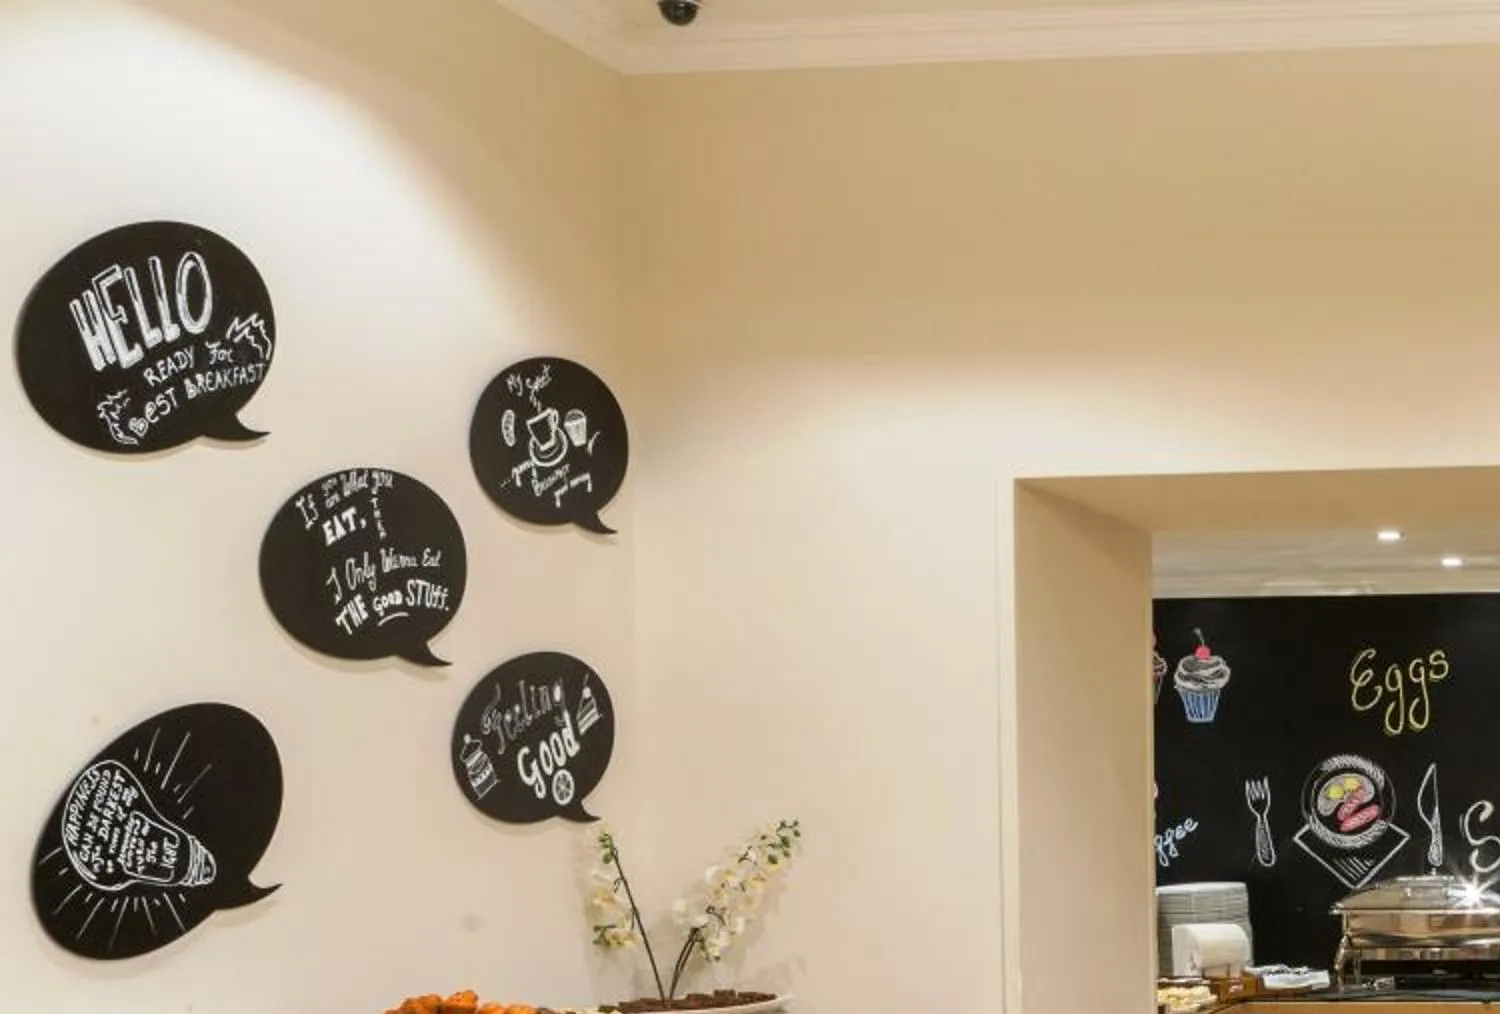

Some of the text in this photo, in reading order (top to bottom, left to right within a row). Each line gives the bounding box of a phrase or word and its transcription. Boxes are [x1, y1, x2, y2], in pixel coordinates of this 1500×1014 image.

[69, 251, 213, 372] HELLO
[143, 346, 196, 388] READY
[184, 363, 266, 399] BREAKFAST
[1349, 647, 1450, 736] Eggs
[1154, 817, 1199, 867] ffee
